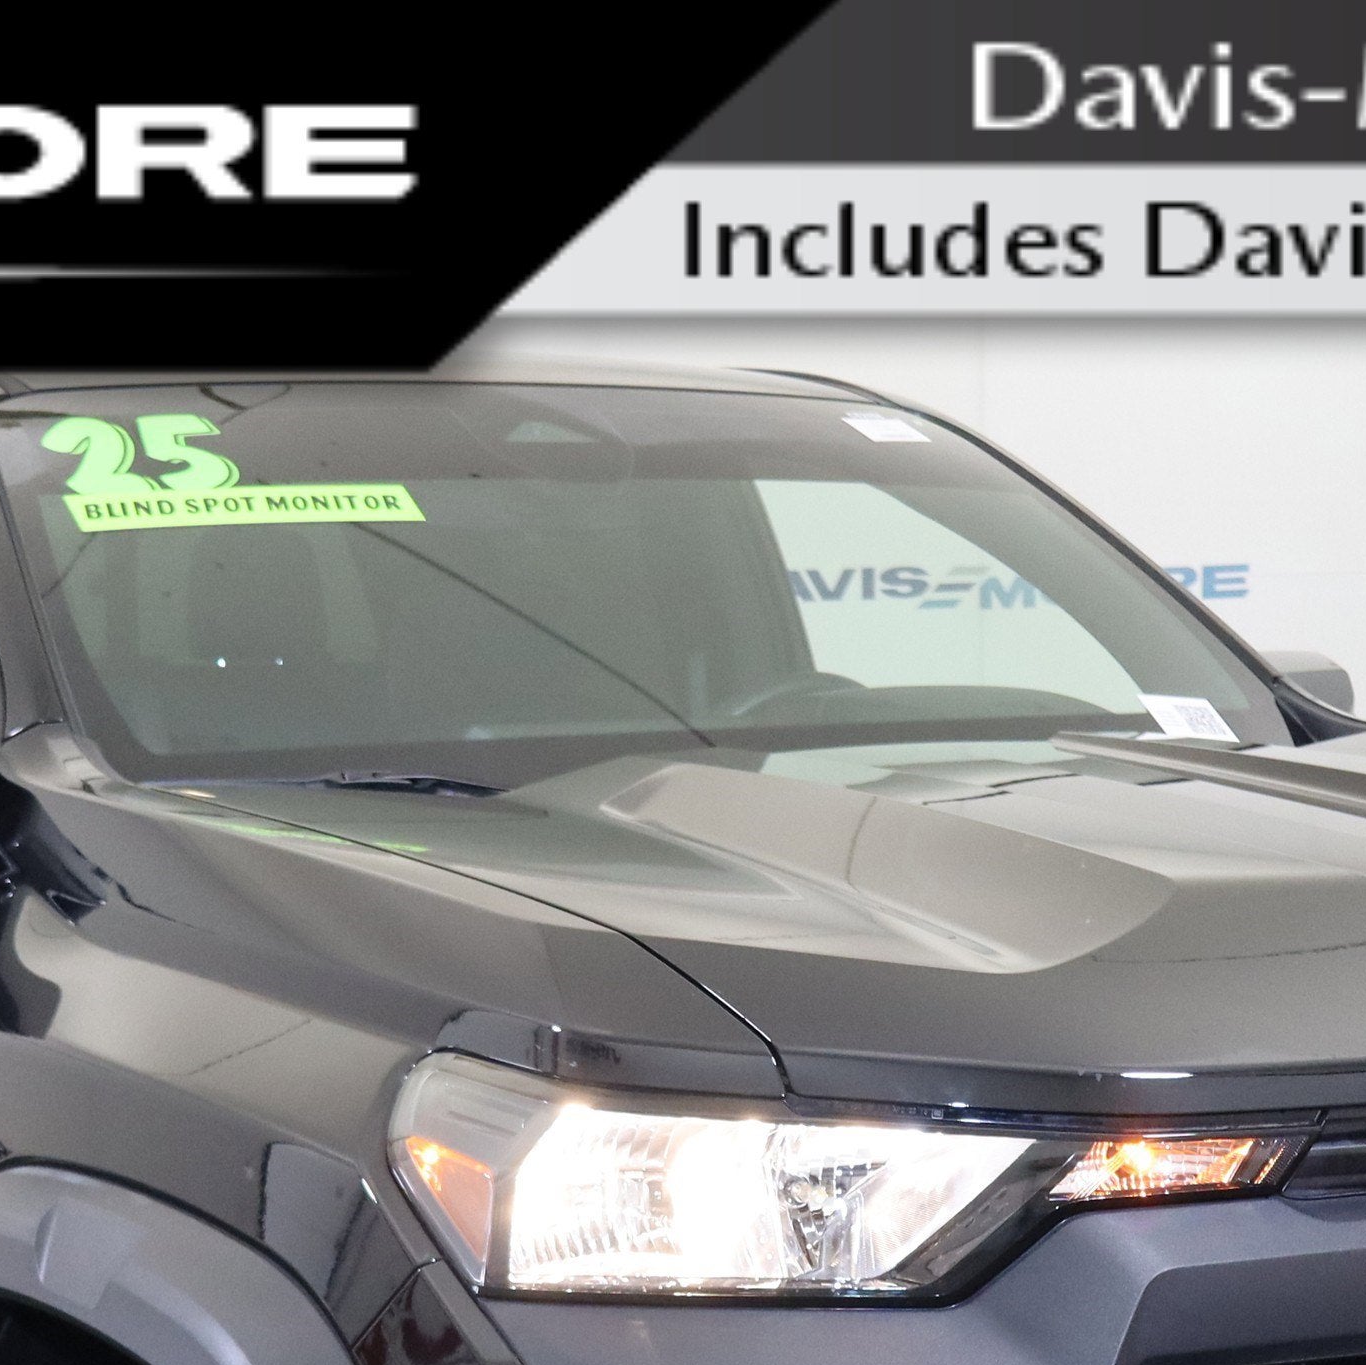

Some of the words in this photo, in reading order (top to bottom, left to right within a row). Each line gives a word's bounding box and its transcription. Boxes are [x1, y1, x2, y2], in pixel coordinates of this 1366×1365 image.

[40, 414, 239, 491] 25
[84, 499, 175, 519] BLIND
[185, 496, 255, 514] SPOT
[265, 495, 401, 512] MONITOR
